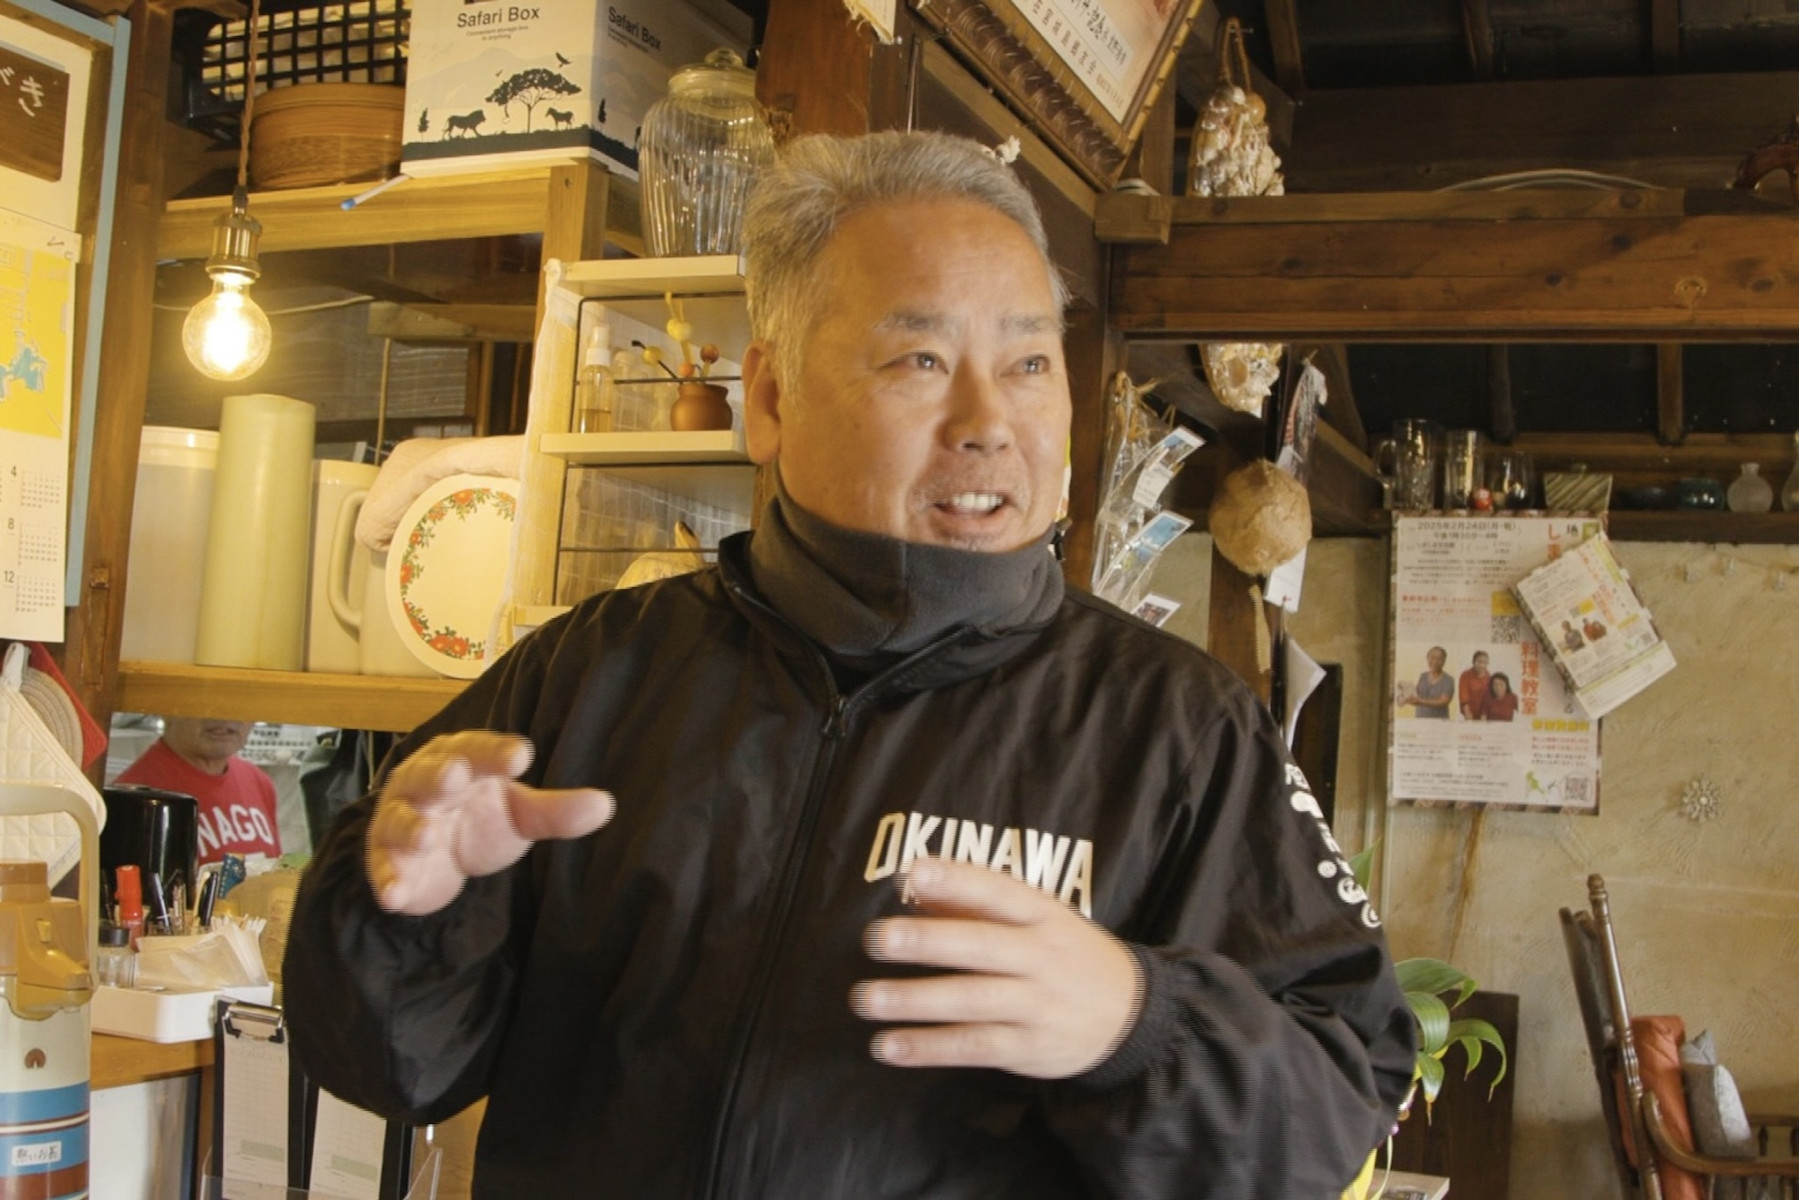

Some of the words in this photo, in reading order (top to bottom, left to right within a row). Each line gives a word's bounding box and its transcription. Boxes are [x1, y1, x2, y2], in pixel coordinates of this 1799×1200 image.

[457, 11, 503, 28] Safari
[510, 6, 540, 21] Box
[608, 6, 639, 37] Safari
[642, 26, 661, 50] Box
[11, 465, 17, 477] 4
[8, 518, 14, 530] 8
[4, 571, 15, 583] 12
[198, 804, 275, 858] NAGO
[864, 811, 1094, 919] OKINAWA
